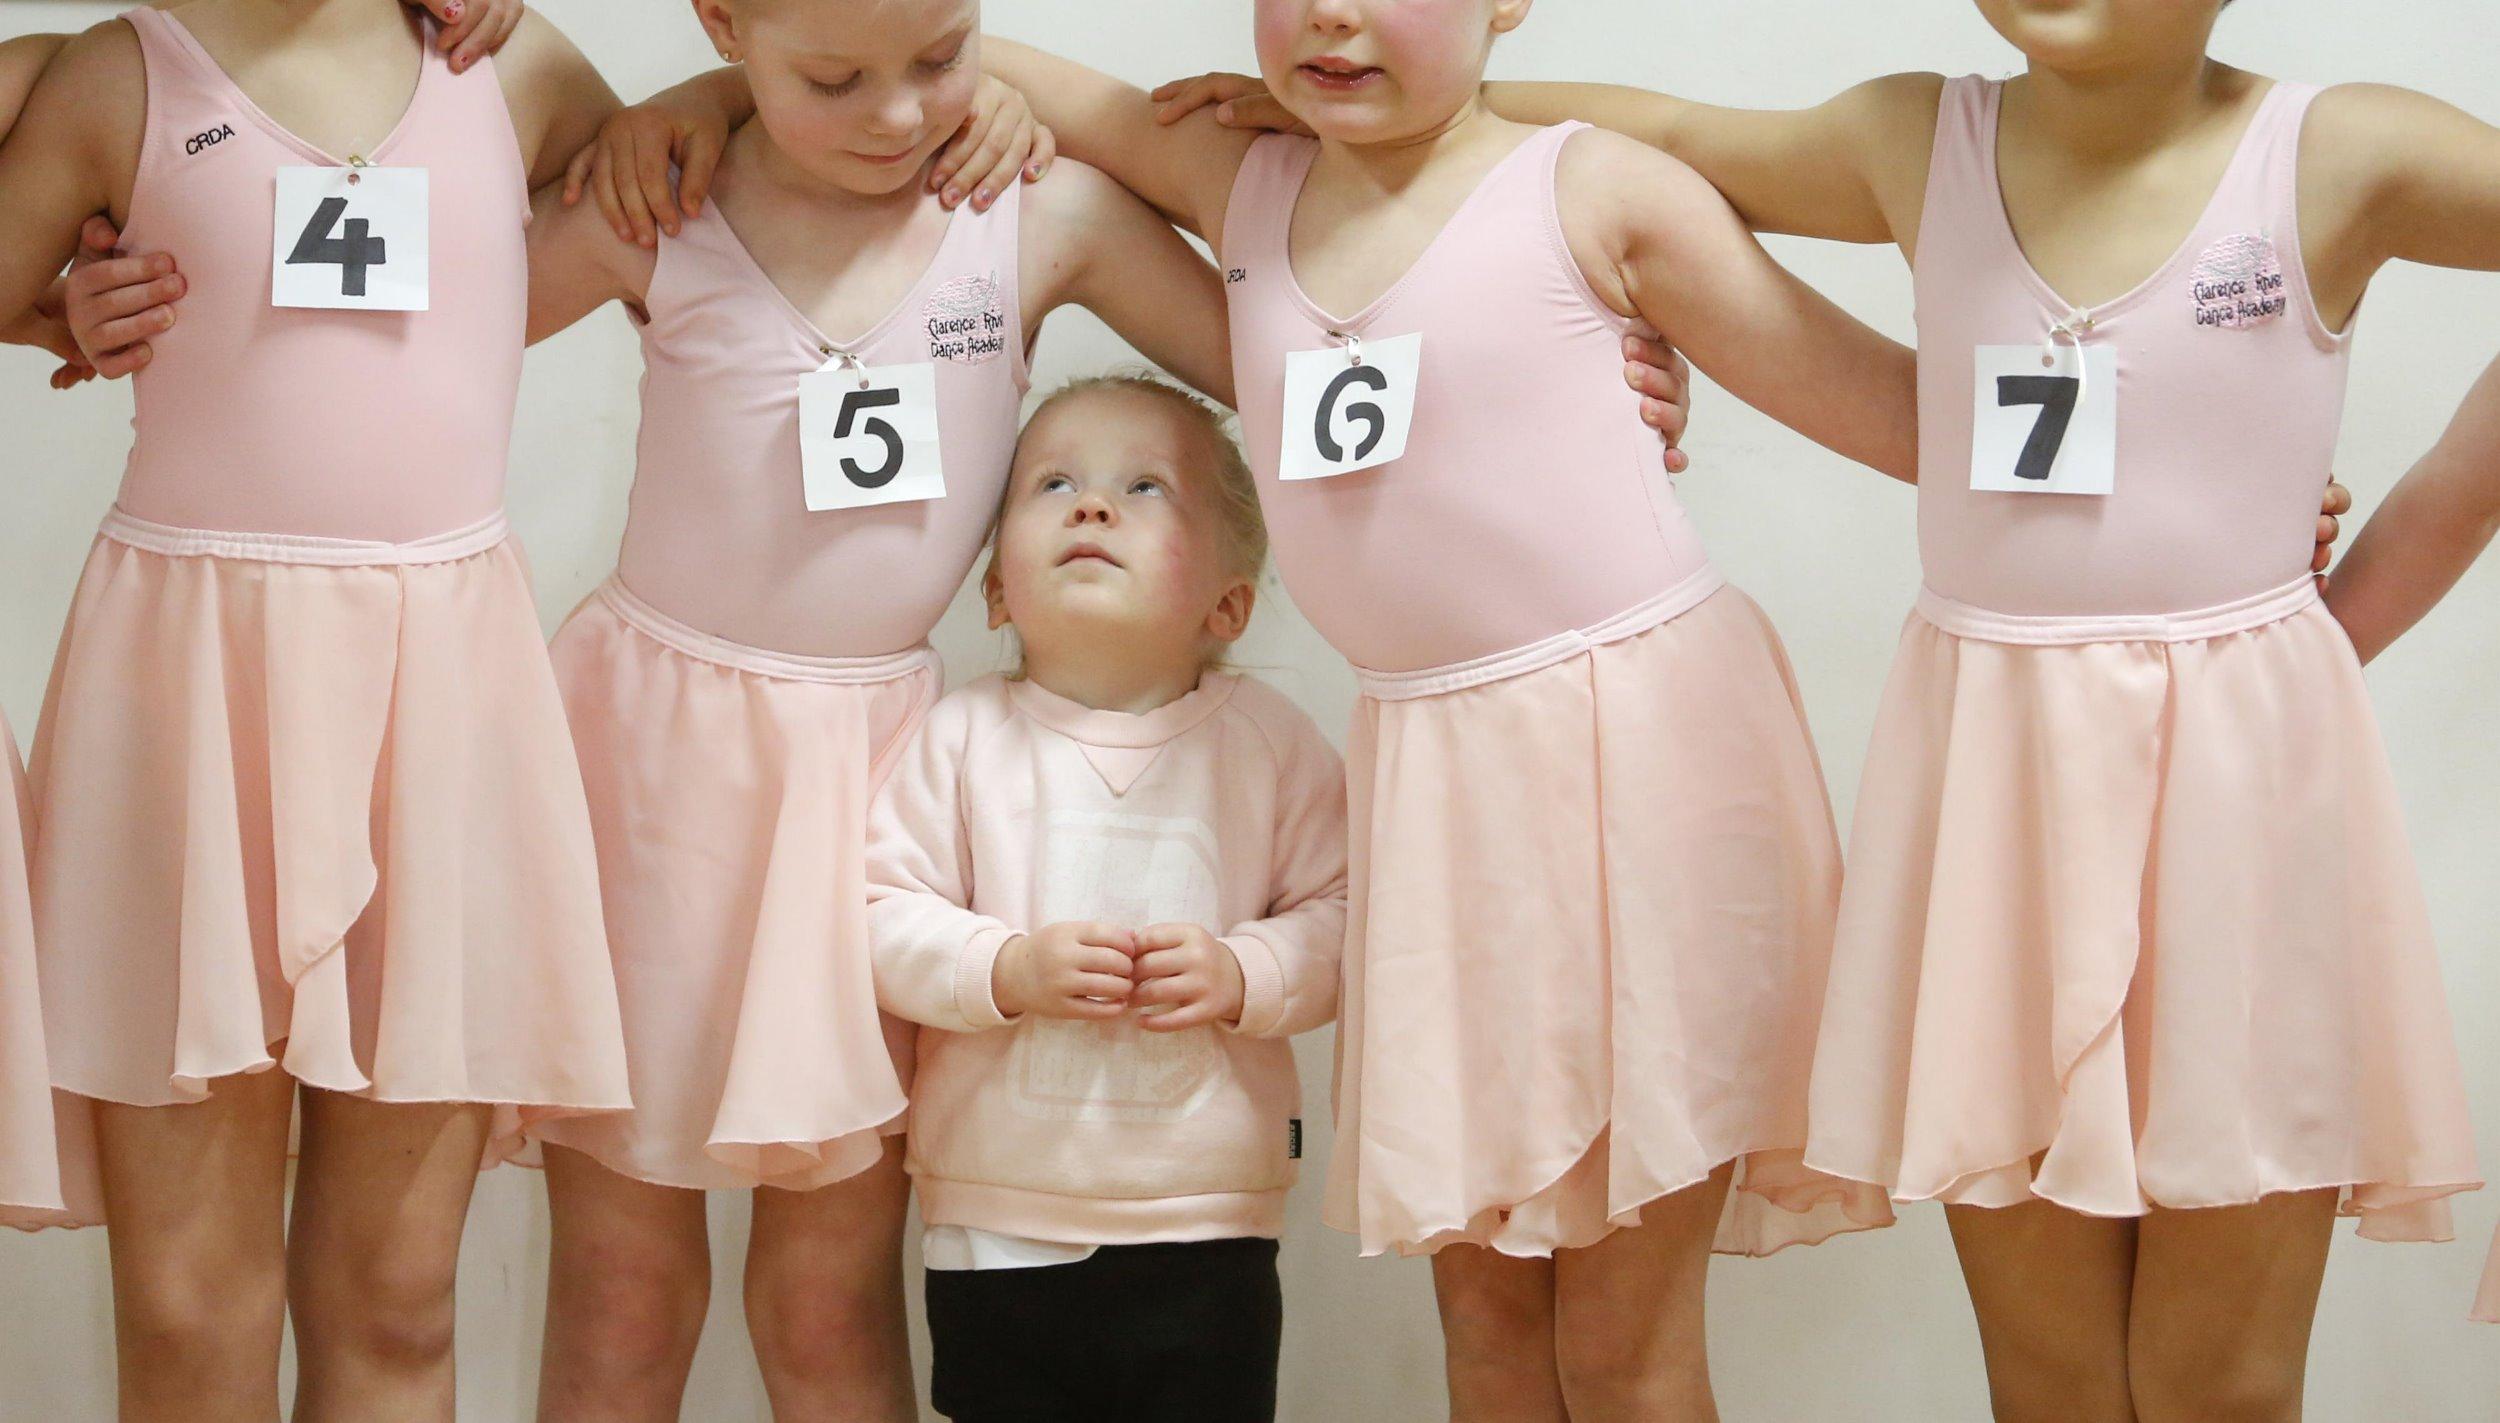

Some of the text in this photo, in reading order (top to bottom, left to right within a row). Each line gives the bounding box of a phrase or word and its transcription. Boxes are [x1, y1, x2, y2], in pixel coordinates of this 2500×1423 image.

[185, 124, 235, 156] CRDA
[285, 197, 386, 297] 4
[2194, 268, 2284, 306] Clarence Rive
[928, 317, 977, 342] Clarence
[2196, 306, 2235, 327] Dance
[930, 341, 965, 361] Dance
[1314, 365, 1388, 463] 6
[1996, 375, 2080, 480] 7
[833, 388, 904, 489] 5
